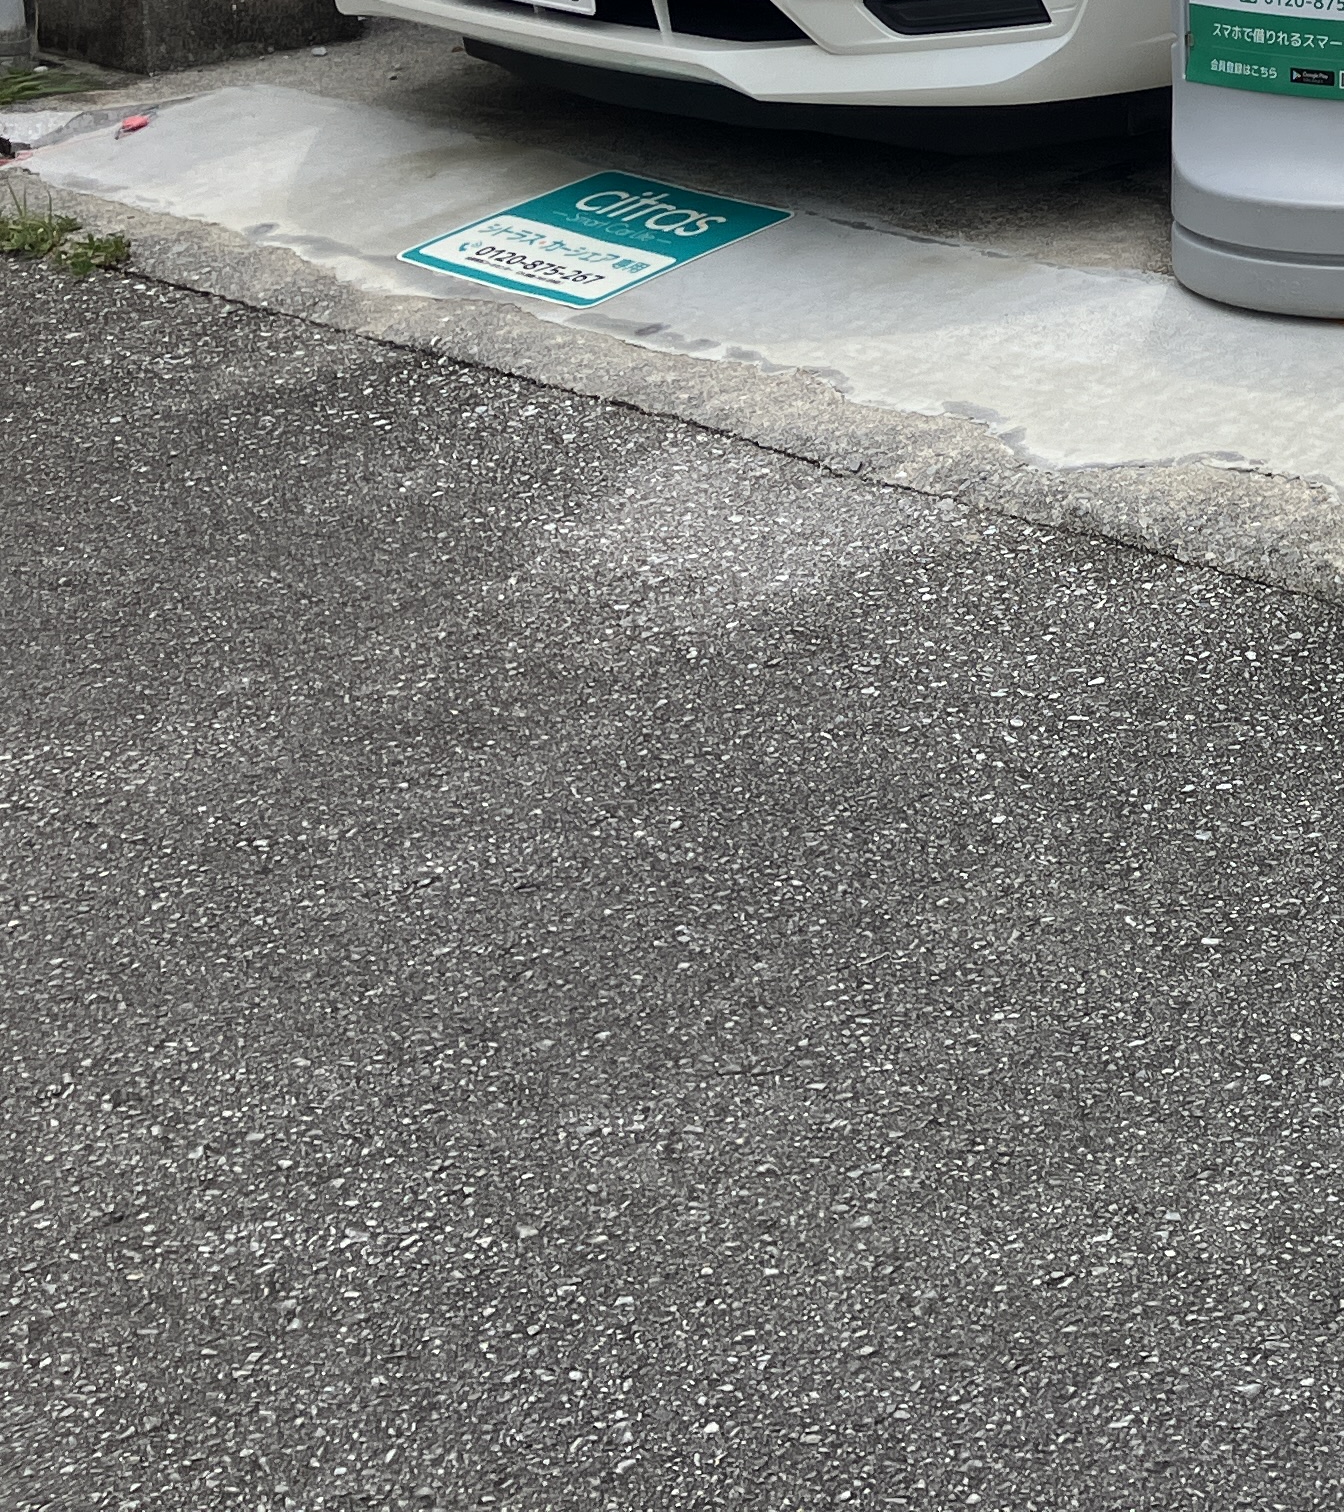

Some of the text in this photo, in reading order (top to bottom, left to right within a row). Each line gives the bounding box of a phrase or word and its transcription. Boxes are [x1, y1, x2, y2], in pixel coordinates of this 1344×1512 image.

[575, 190, 727, 237] citras
[478, 223, 622, 263] シトラス・カーシェア
[474, 246, 605, 285] 0120-875-267
